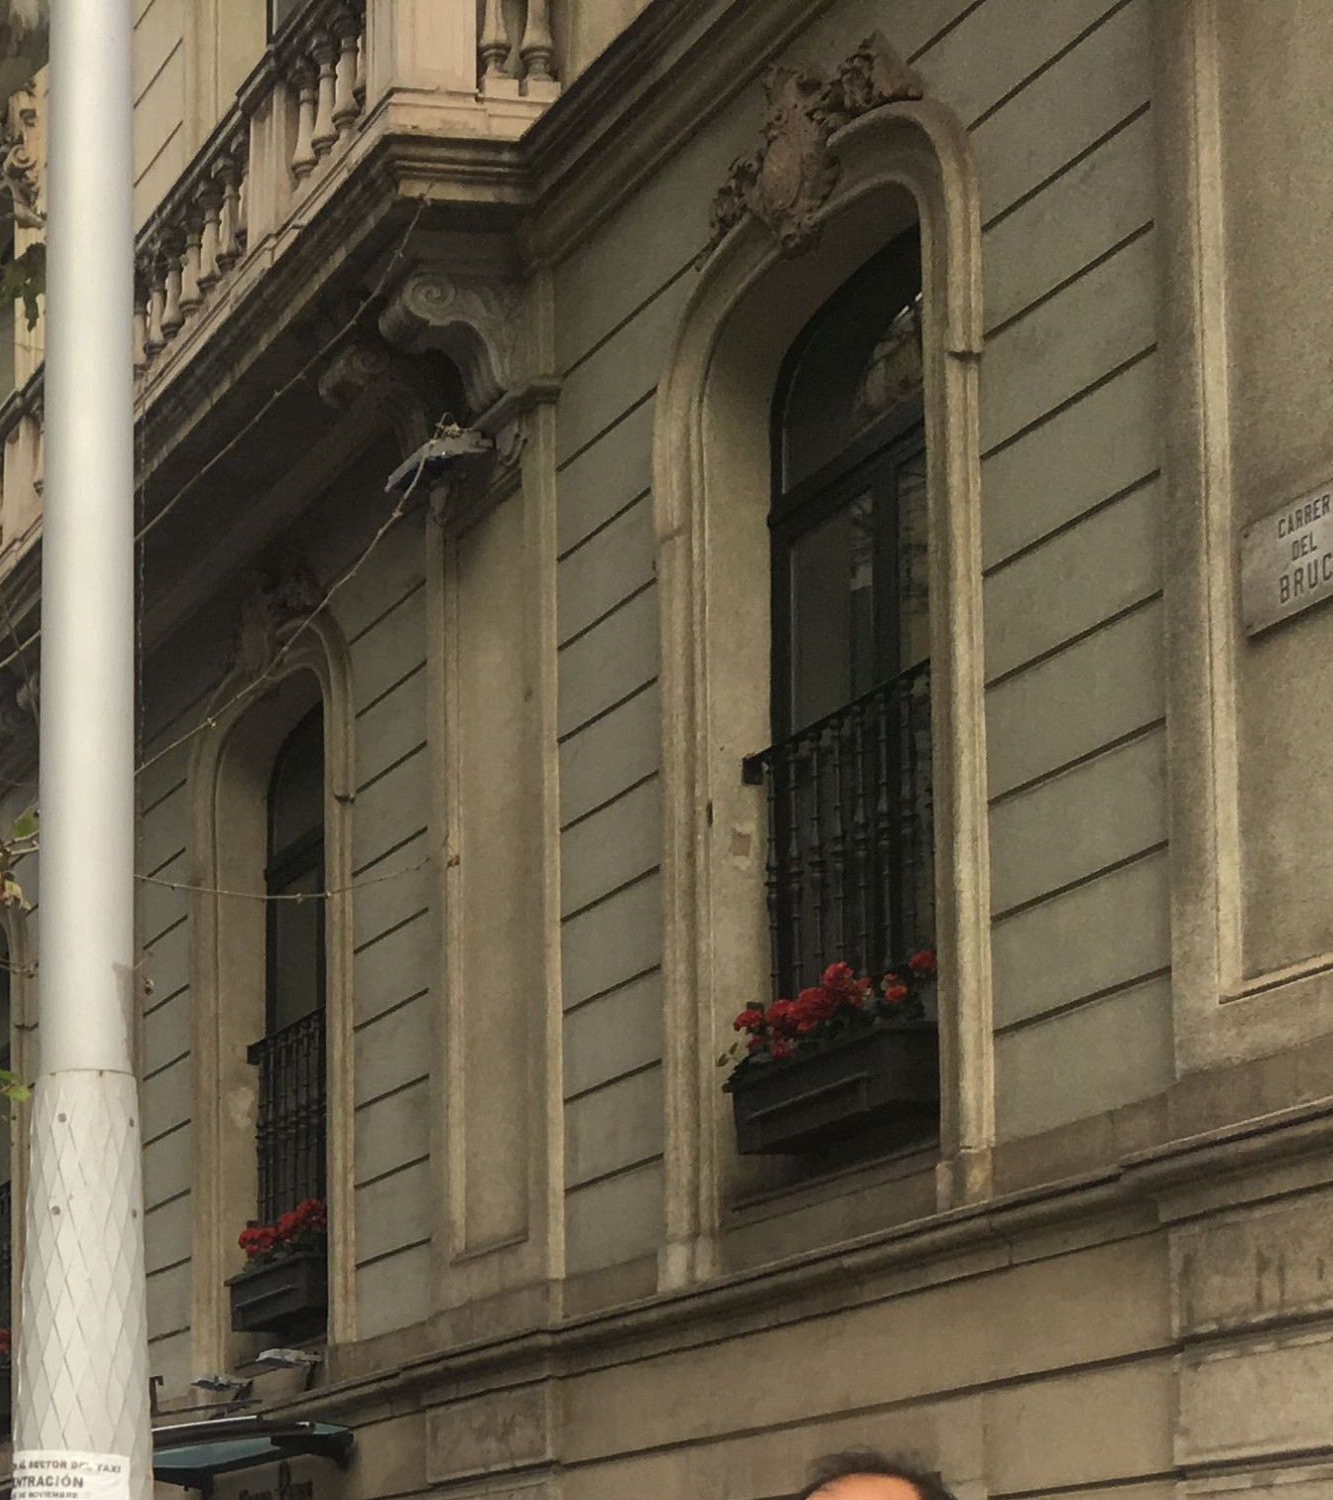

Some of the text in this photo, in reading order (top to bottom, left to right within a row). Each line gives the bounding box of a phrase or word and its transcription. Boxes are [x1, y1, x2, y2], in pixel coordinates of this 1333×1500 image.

[1278, 493, 1331, 538] CARRER
[1291, 531, 1318, 561] DEL
[28, 1460, 68, 1470] SECTOR
[97, 1463, 122, 1473] TAXI
[28, 1491, 79, 1499] NOVIEMBRE
